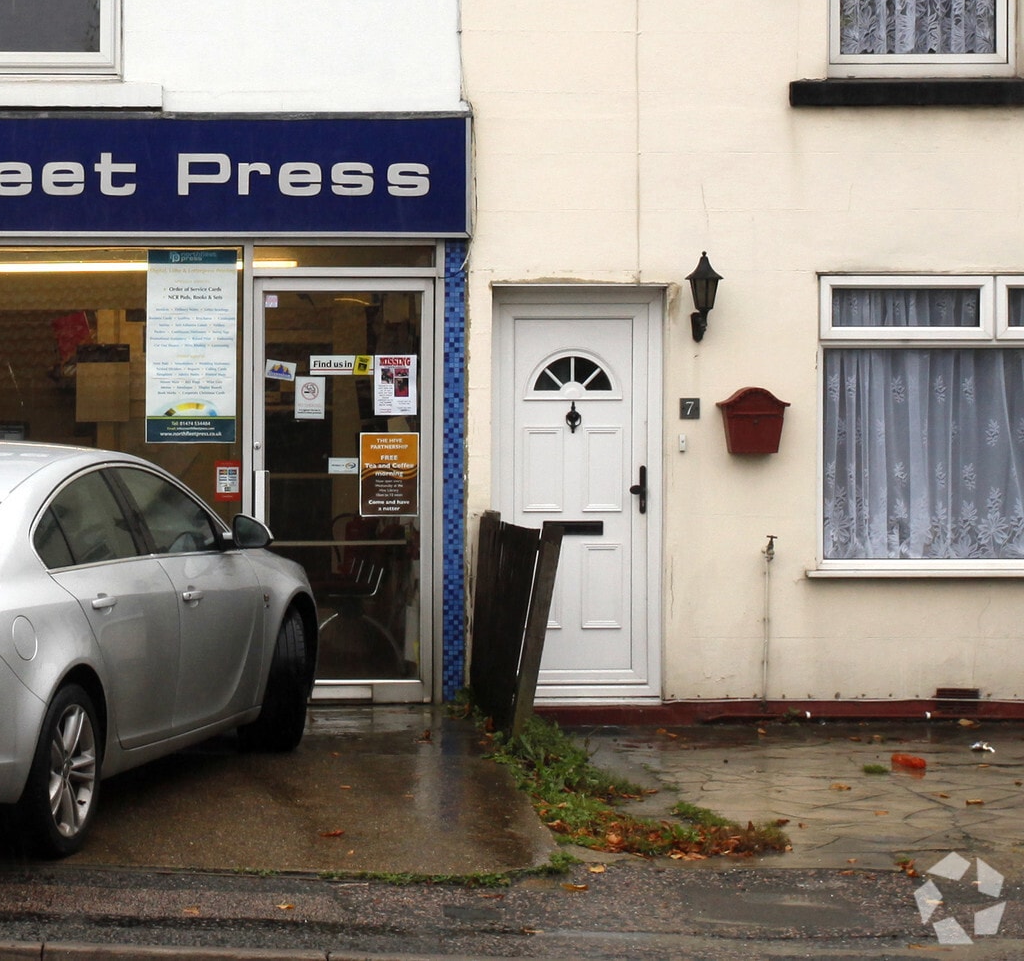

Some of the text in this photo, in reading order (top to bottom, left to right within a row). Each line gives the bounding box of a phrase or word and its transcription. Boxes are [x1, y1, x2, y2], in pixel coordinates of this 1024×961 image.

[177, 152, 431, 197] Press
[313, 360, 332, 368] Find
[344, 360, 352, 368] in
[379, 357, 411, 366] MISSING
[685, 401, 694, 415] 7
